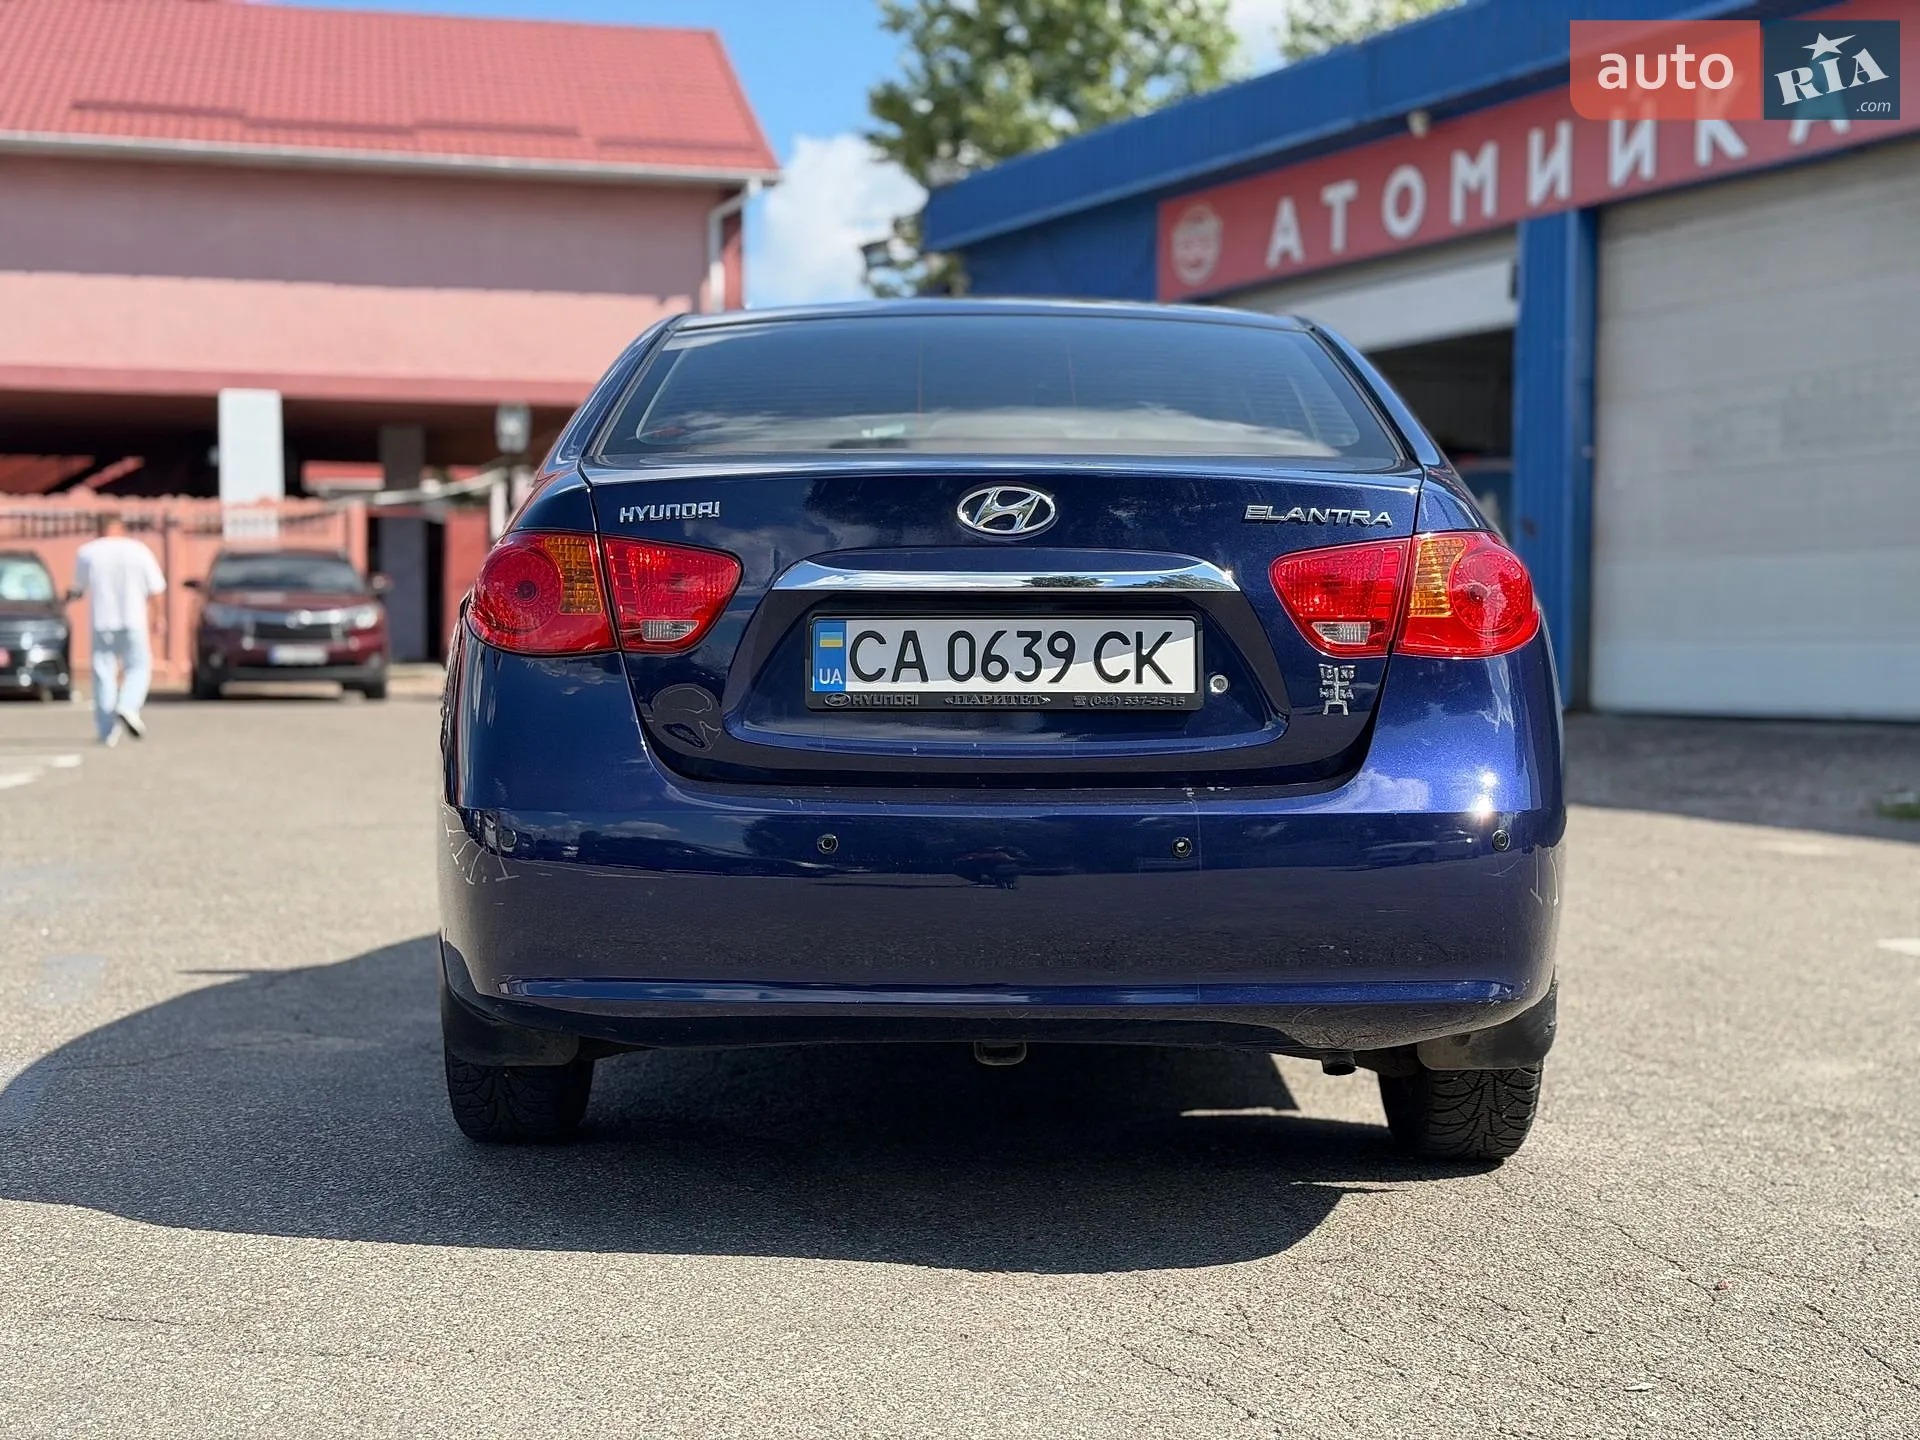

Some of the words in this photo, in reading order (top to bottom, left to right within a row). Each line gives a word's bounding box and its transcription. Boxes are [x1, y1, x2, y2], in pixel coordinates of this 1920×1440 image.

[620, 501, 720, 522] HYUNDAI
[1244, 505, 1393, 526] ELANTRA
[849, 630, 929, 683] CA
[947, 630, 1076, 683] 0639
[1093, 631, 1173, 684] CK
[819, 669, 843, 685] UA
[852, 694, 919, 705] HYUNDAI
